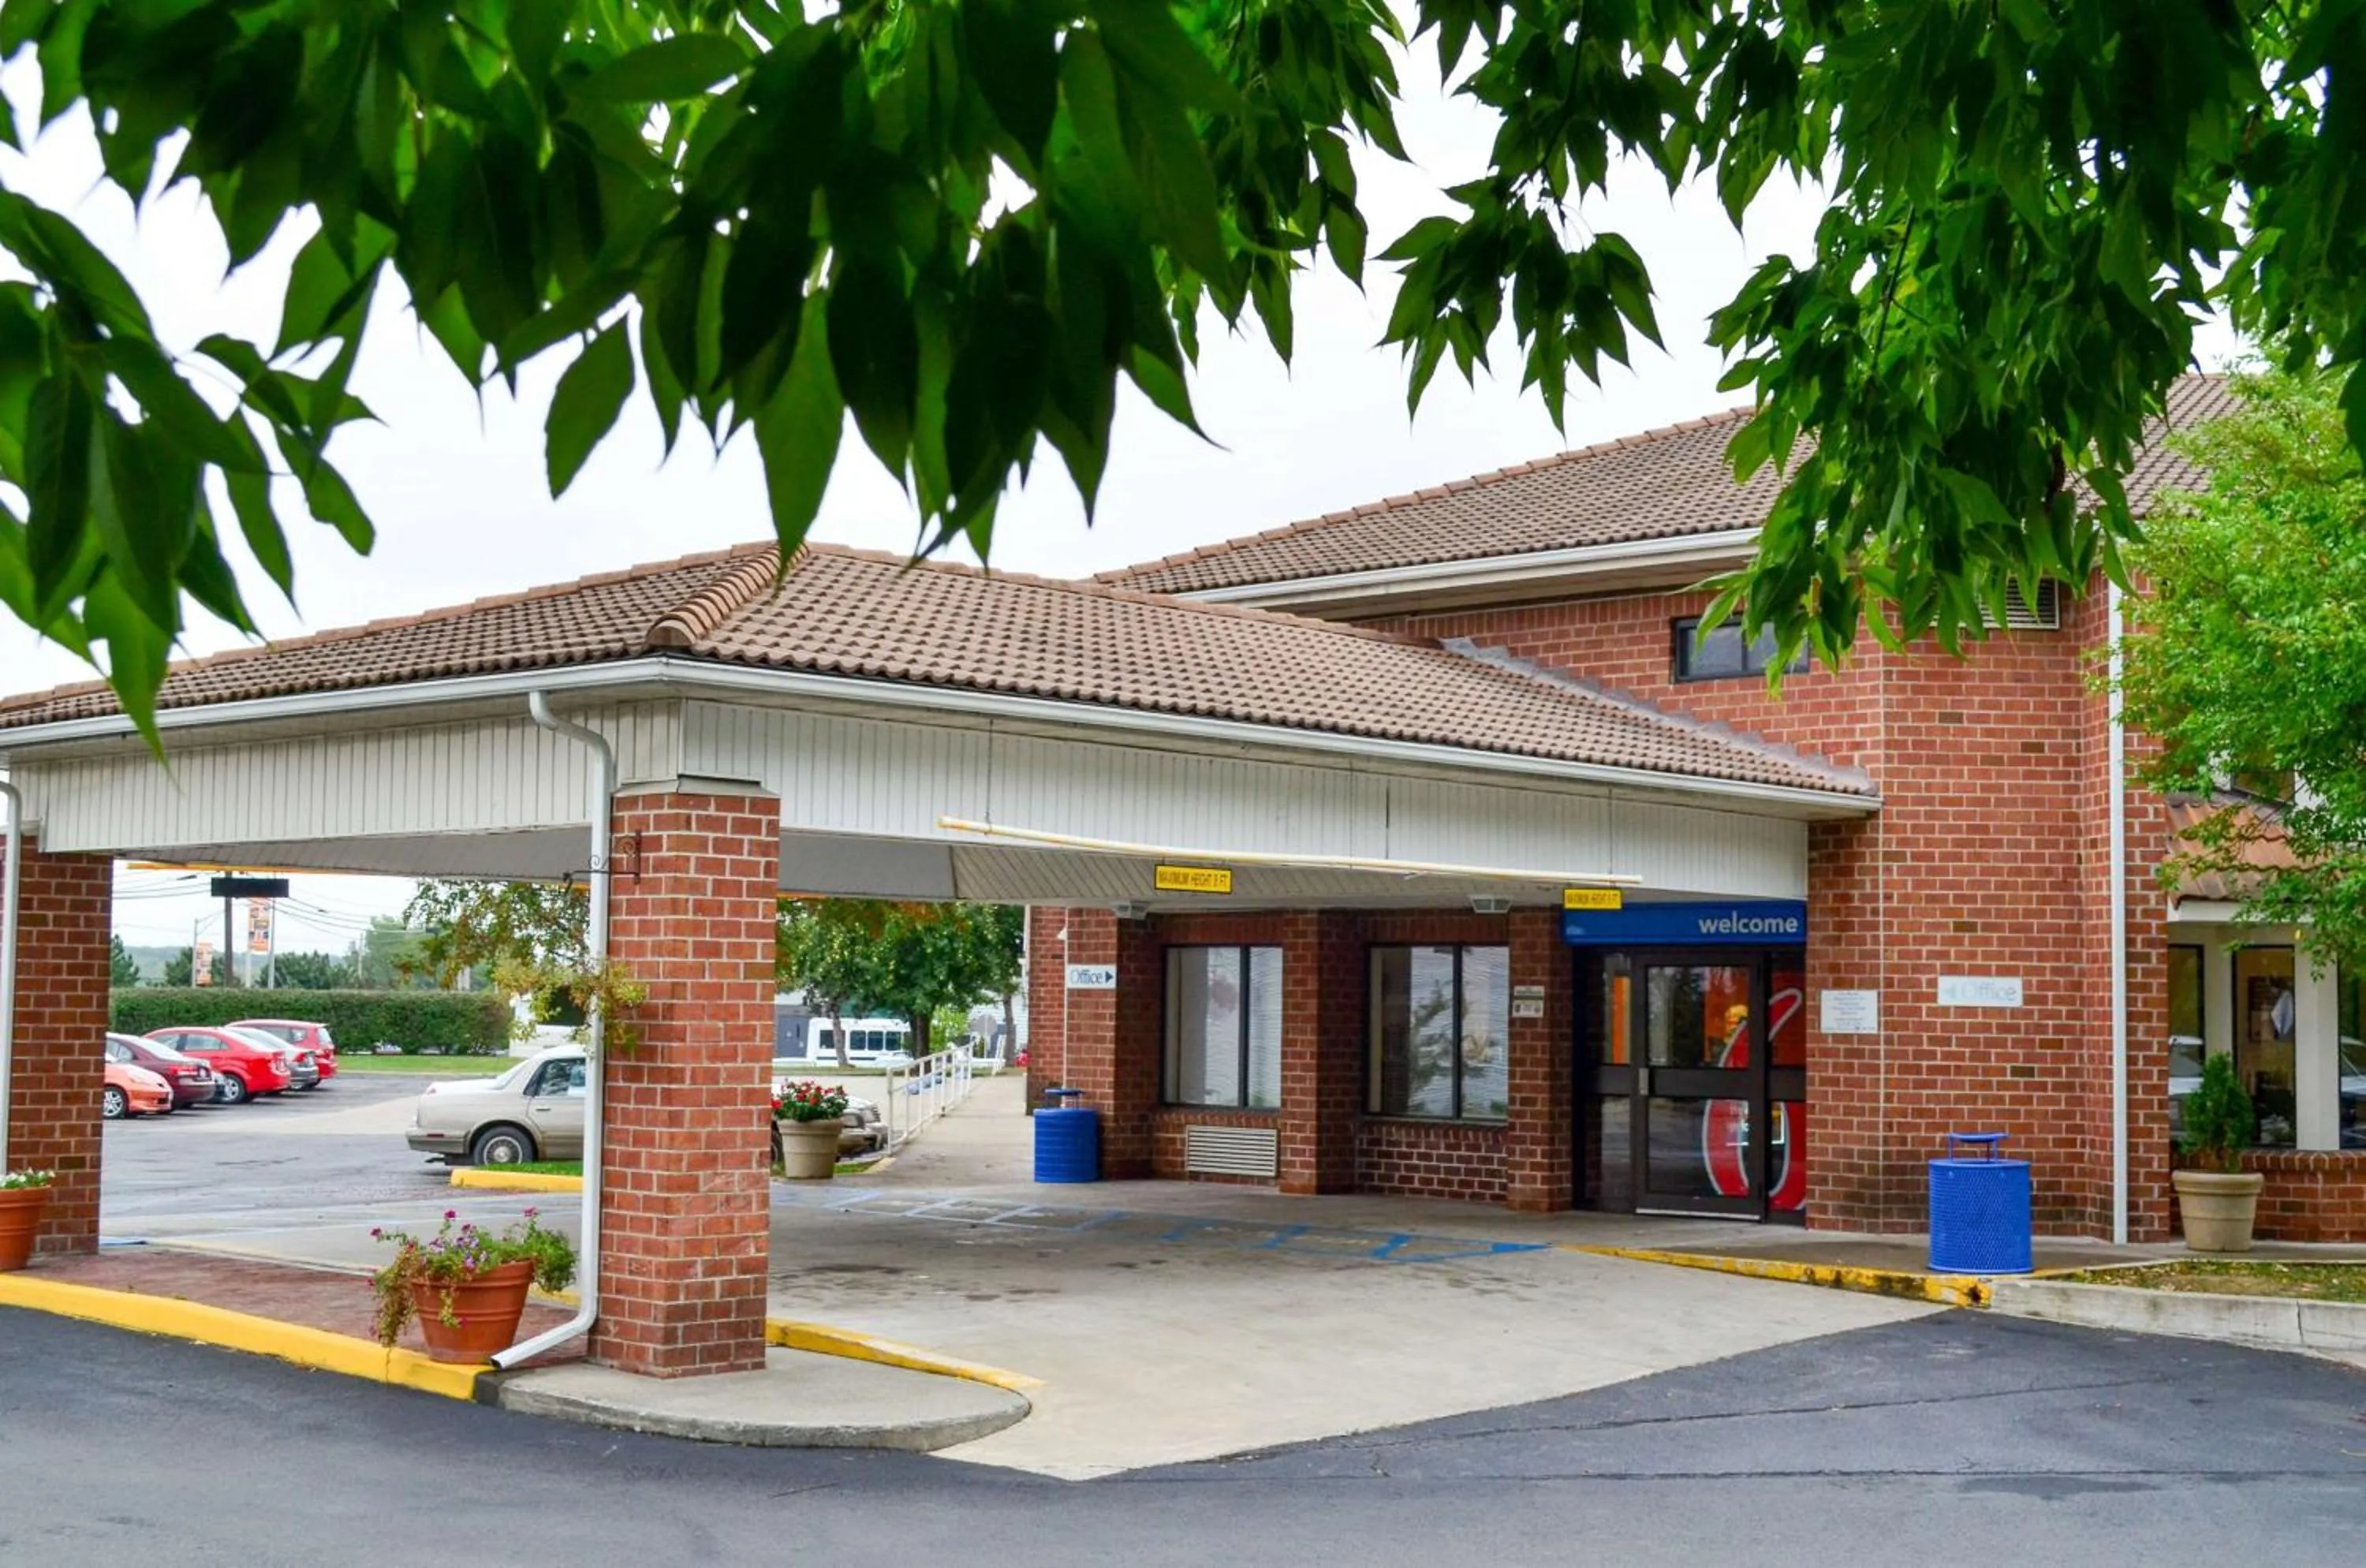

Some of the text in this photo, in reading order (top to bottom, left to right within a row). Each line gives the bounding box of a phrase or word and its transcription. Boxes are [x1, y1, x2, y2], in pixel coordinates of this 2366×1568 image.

[1698, 909, 1799, 934] welcome
[1069, 969, 1103, 984] Office
[1961, 982, 2017, 1002] Office
